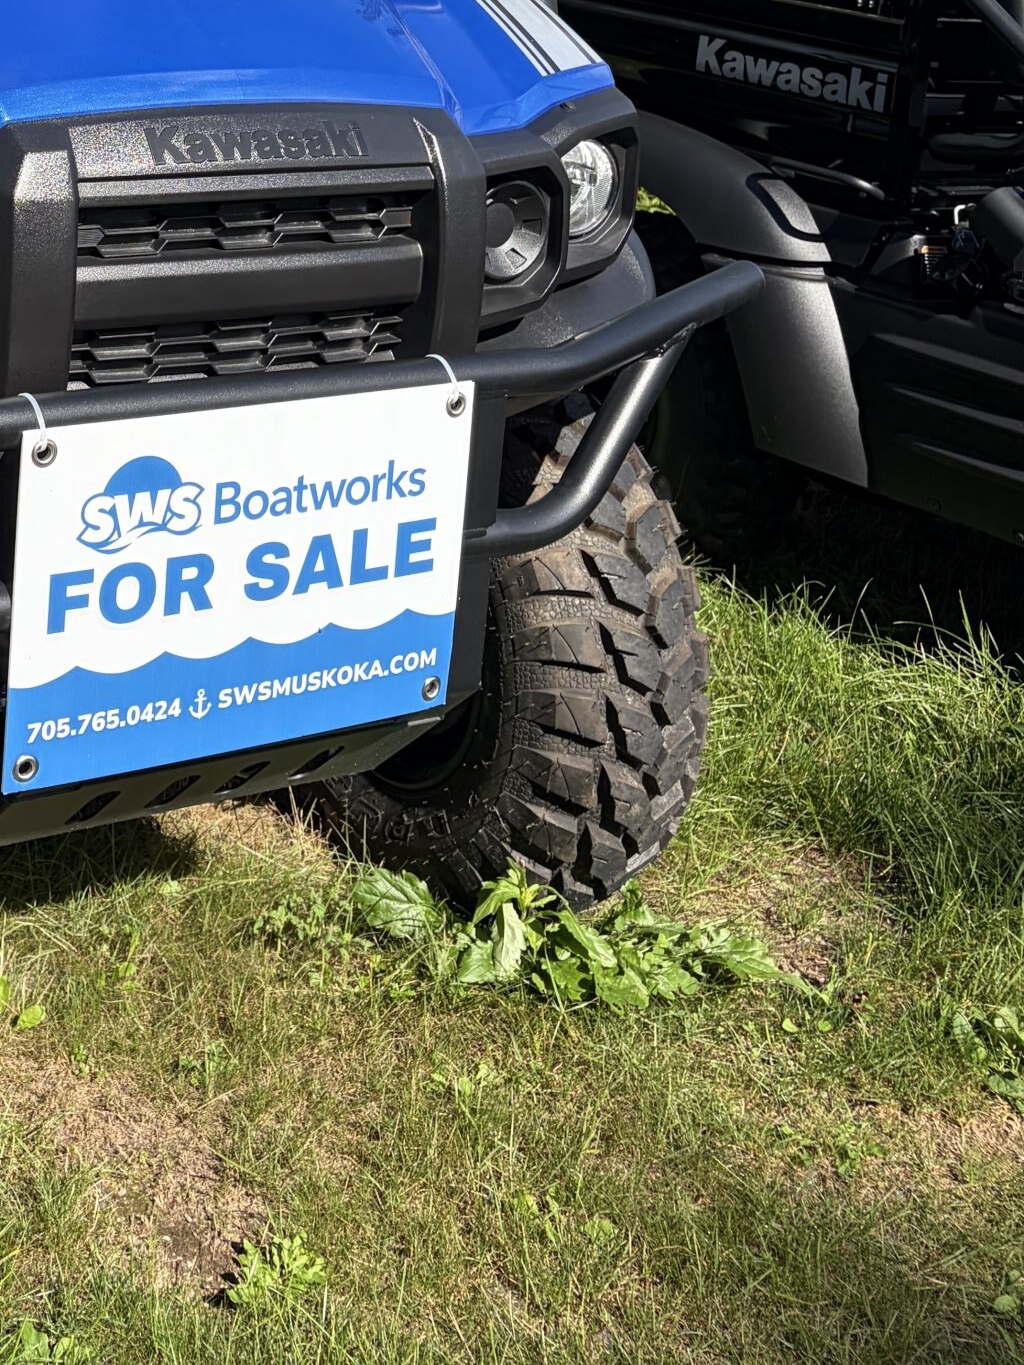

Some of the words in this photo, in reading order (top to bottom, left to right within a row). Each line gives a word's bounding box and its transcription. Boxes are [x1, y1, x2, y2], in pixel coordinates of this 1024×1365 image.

[695, 35, 888, 113] Kawasaki
[144, 120, 369, 165] Kawasaki
[77, 482, 204, 548] SWS
[214, 460, 426, 524] Boatworks
[47, 553, 215, 635] FOR
[244, 517, 437, 601] SALE
[27, 698, 181, 743] 705.765.0424
[218, 647, 437, 709] SWSMUSKOKA.COM
